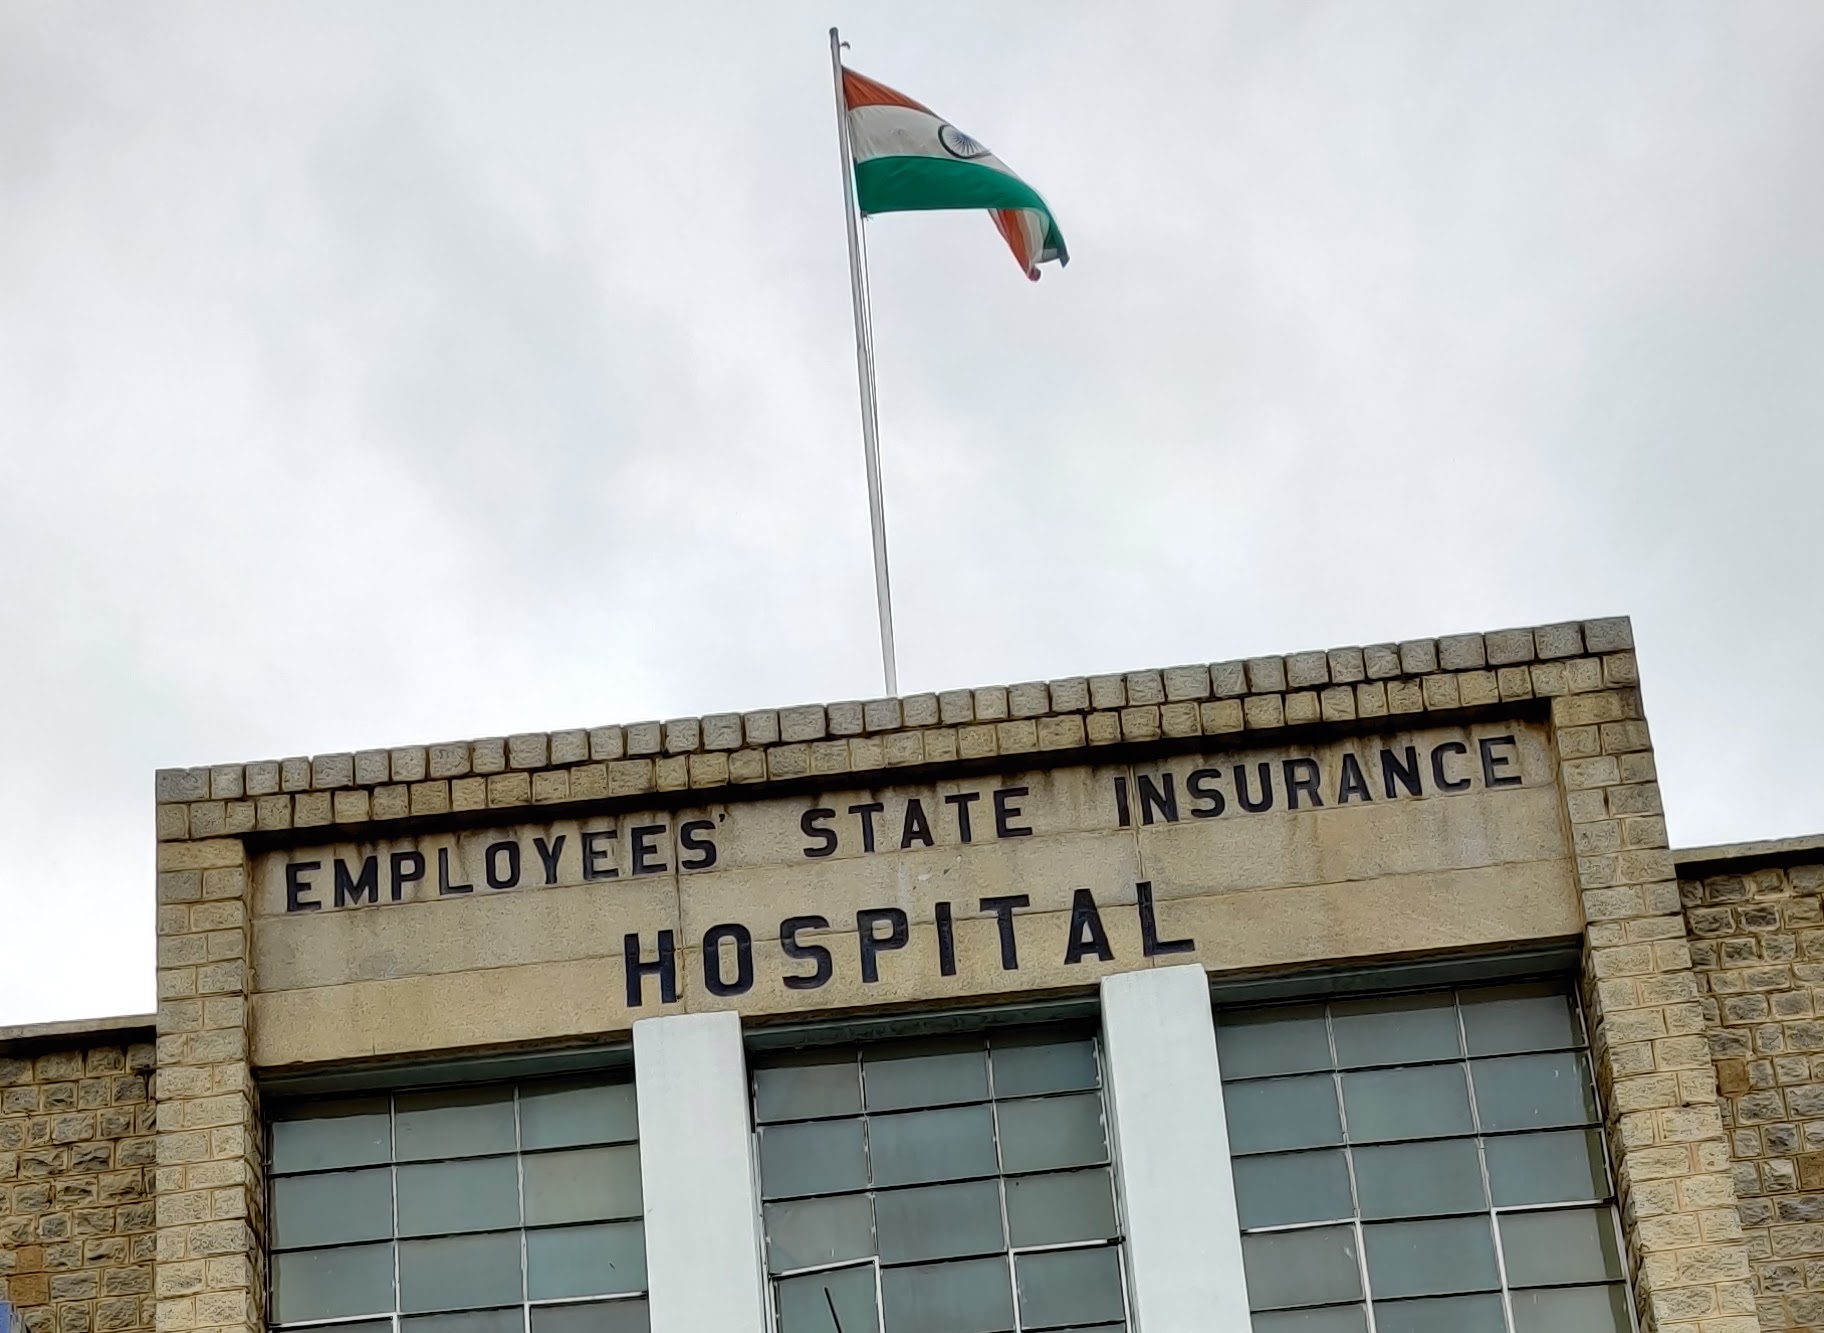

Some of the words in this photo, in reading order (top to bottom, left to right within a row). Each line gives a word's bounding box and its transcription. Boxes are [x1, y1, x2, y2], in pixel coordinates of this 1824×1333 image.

[285, 813, 725, 913] EMPLOYEES'
[800, 786, 1033, 857] STATE
[1113, 735, 1523, 827] INSURANCE
[624, 881, 1195, 1008] HOSPITAL
